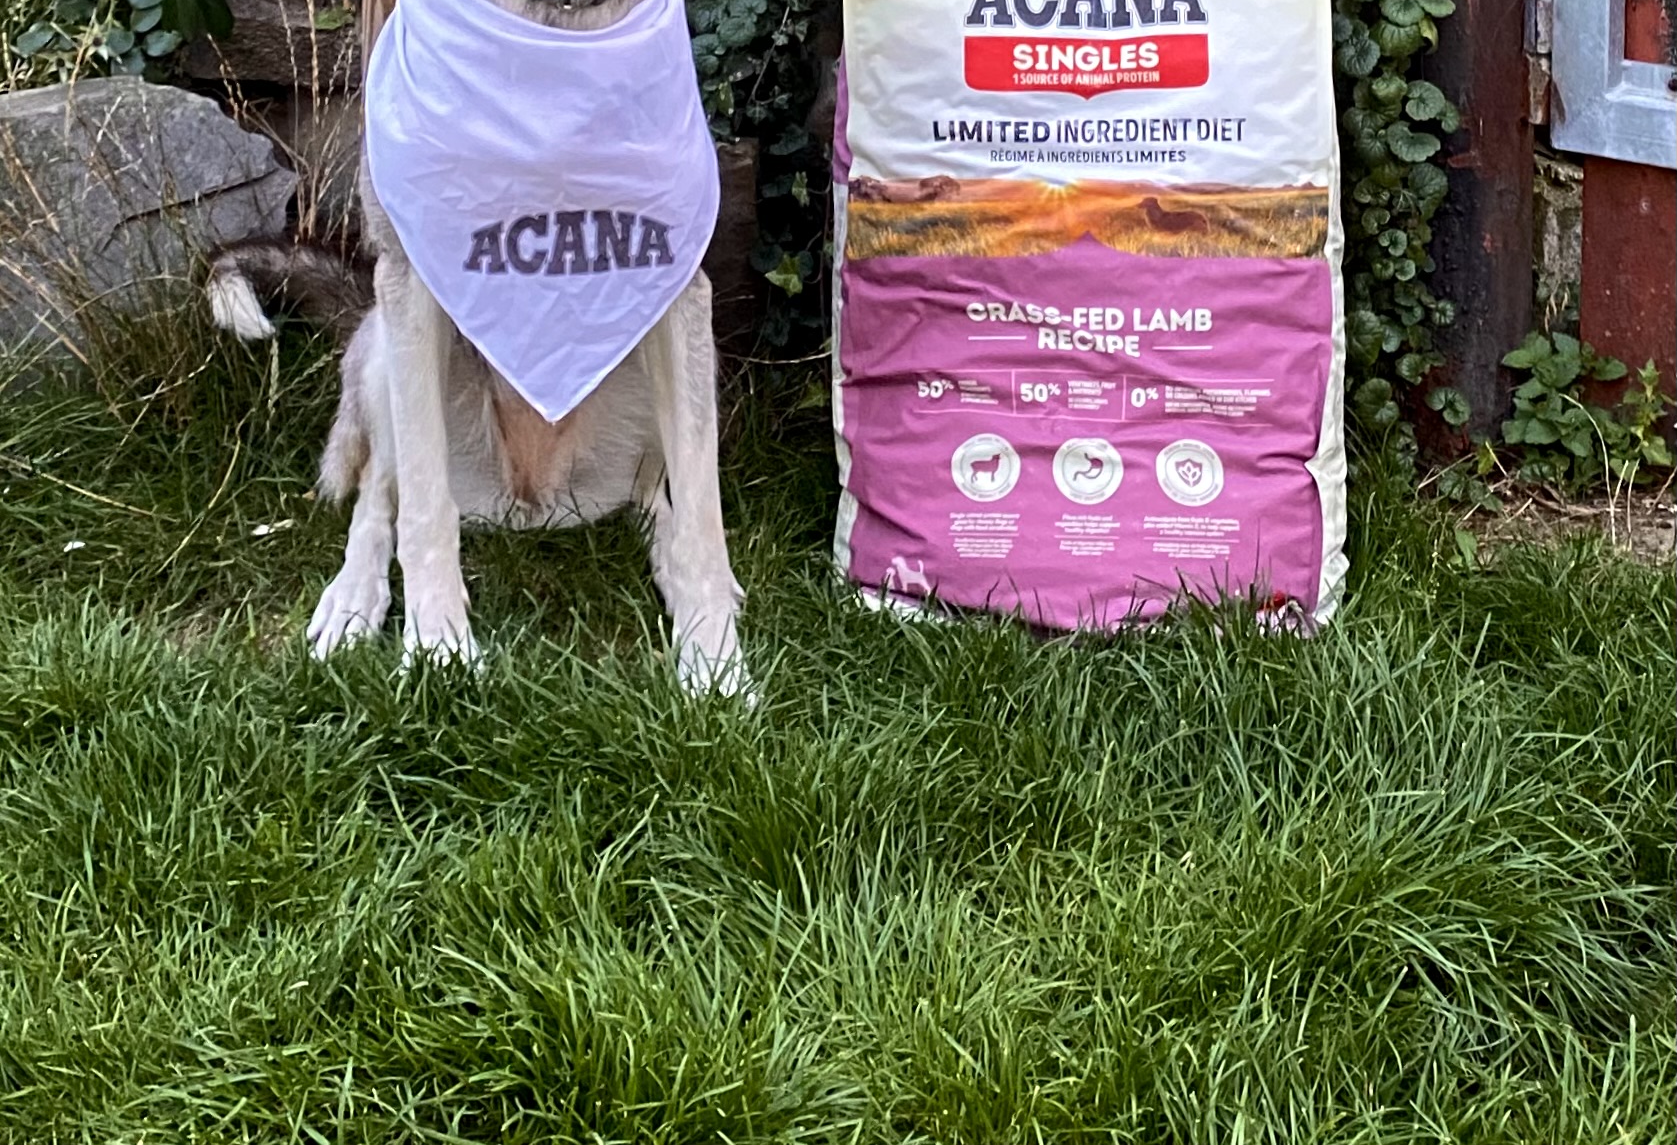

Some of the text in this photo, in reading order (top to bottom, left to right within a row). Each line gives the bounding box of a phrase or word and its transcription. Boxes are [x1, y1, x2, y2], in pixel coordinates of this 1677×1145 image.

[1013, 42, 1160, 71] SINGLES
[1013, 71, 1161, 86] 1 SOURCE OF ANIMAL PROTEIN
[932, 118, 1247, 144] LIMITED INGREDIENT DIET
[989, 148, 1035, 163] RÉGIME
[1046, 148, 1124, 163] INGRÉDIENTS
[1126, 148, 1187, 163] LIMITÉS
[463, 209, 675, 275] ACANA
[966, 302, 1214, 332] GRASS-FED LAMB
[1037, 328, 1141, 357] RECIPE
[917, 379, 955, 399] 50%
[1020, 382, 1061, 403] 50%
[1130, 387, 1159, 408] 0%
